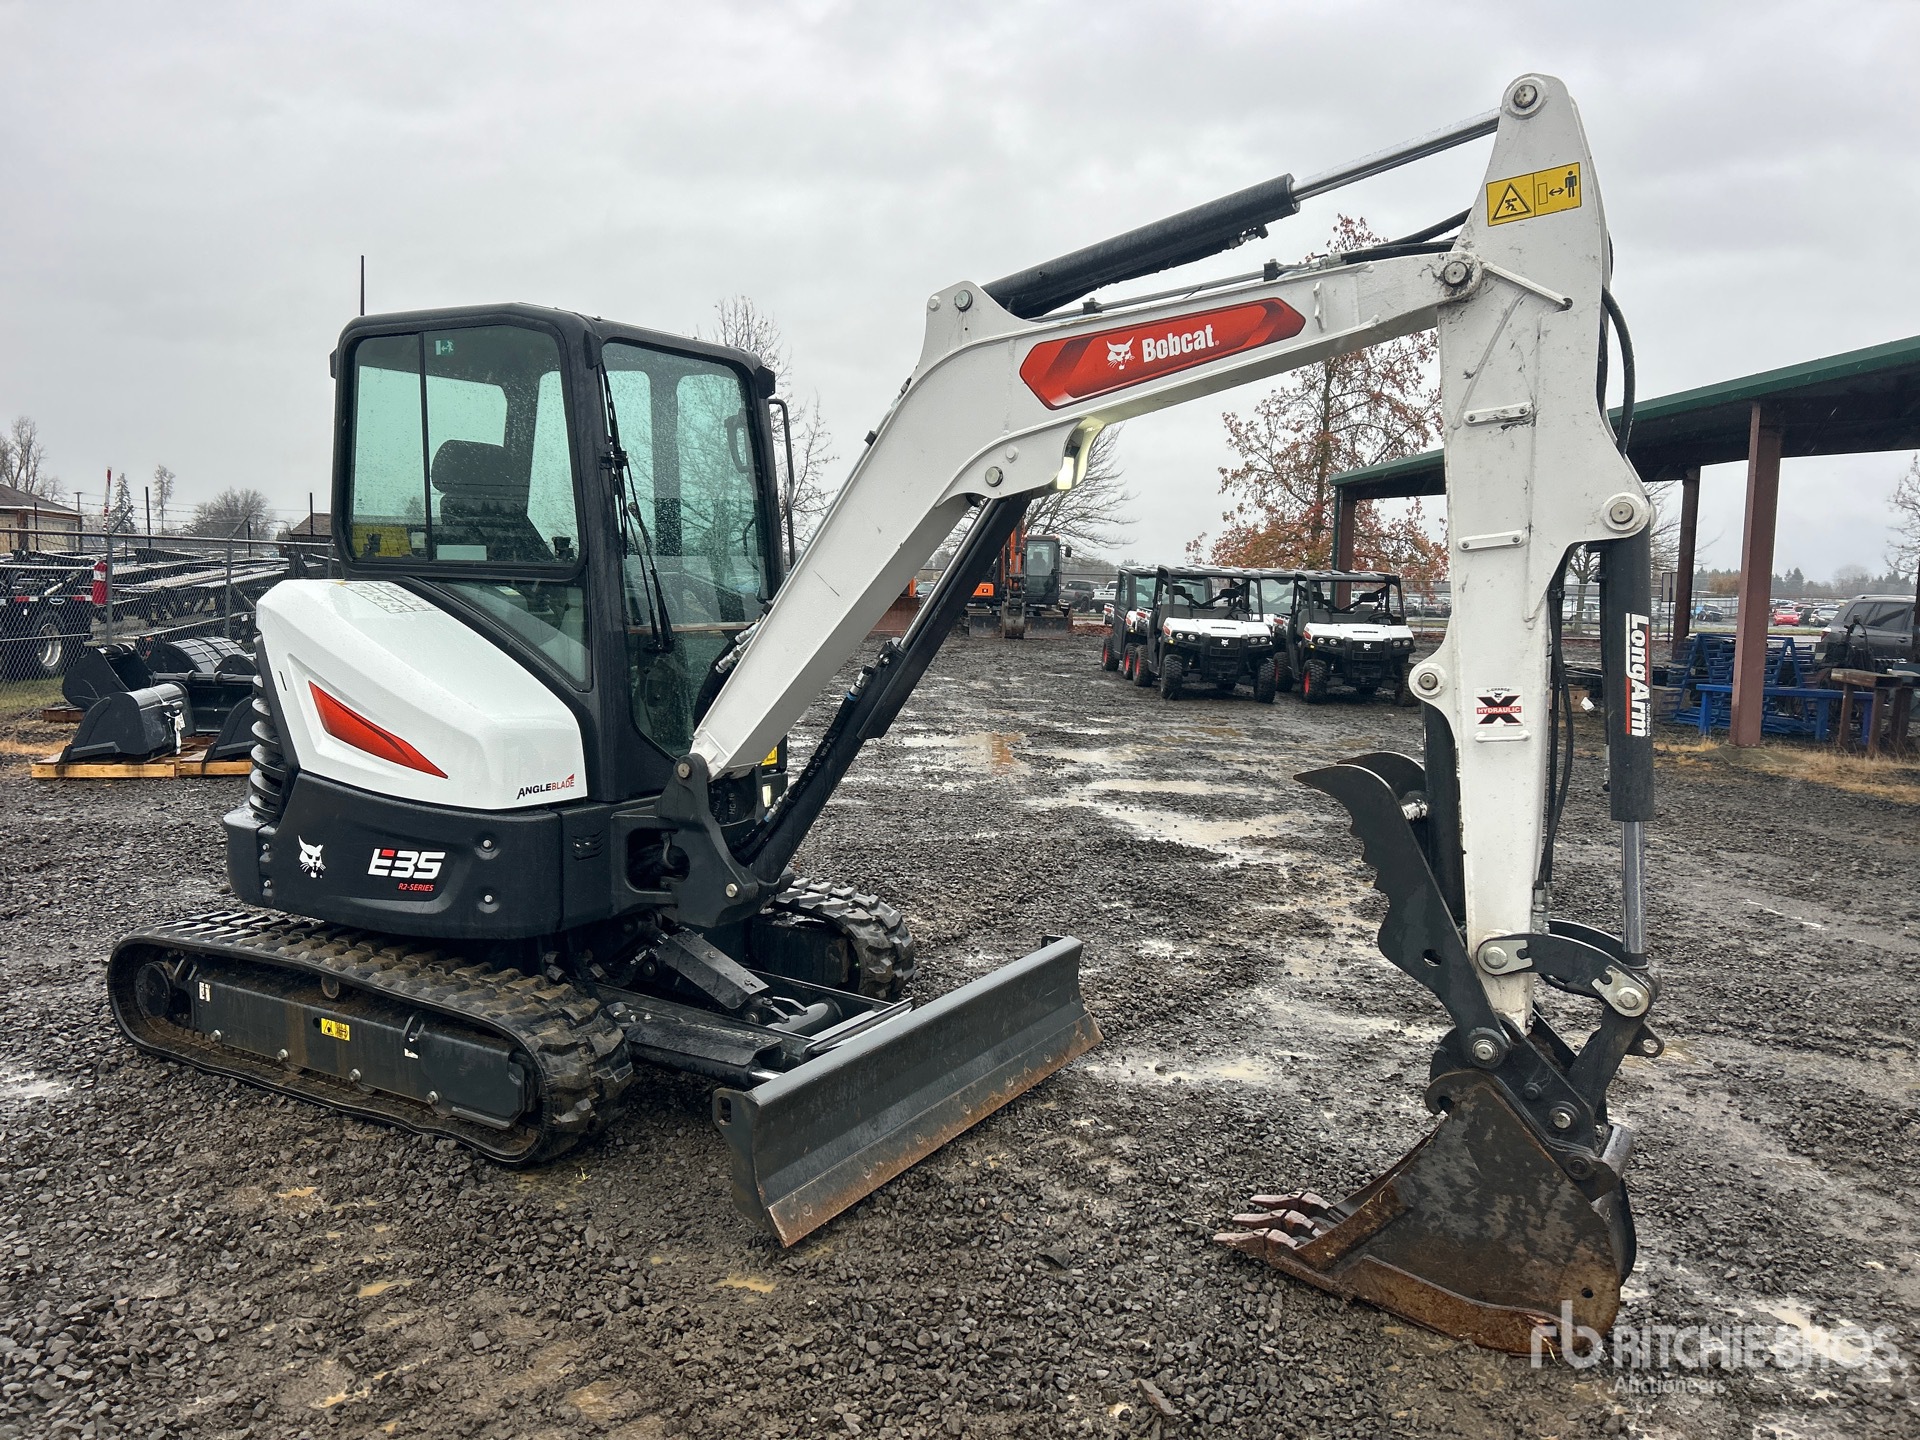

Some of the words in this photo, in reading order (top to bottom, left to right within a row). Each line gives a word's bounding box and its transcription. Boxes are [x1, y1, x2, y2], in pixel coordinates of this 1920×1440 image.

[1142, 324, 1214, 363] Bobcat
[1626, 613, 1650, 737] LongArm
[517, 777, 575, 800] ANGLEBLADE
[367, 848, 446, 879] E35
[398, 883, 434, 892] R2-SERIES
